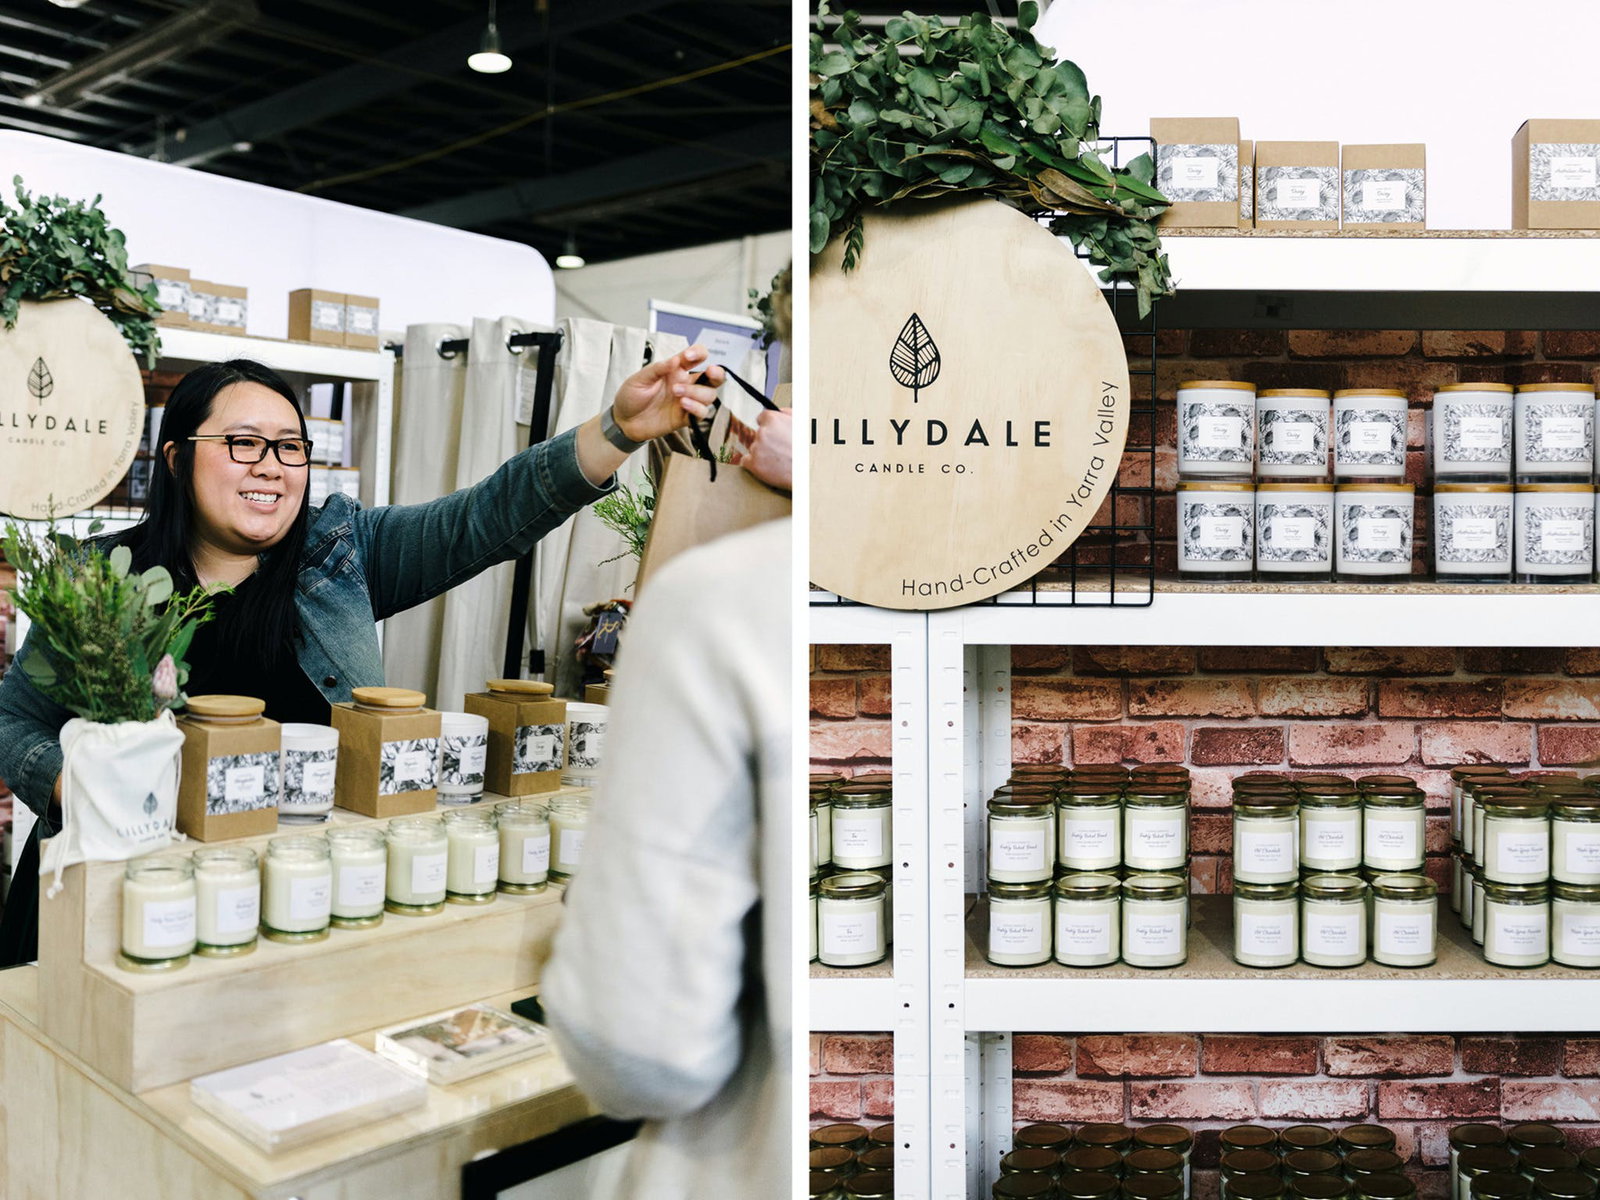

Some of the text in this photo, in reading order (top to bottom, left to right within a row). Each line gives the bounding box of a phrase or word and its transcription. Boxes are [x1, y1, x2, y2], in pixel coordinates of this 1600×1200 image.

[7, 436, 45, 446] CANDLE
[811, 418, 1051, 447] ILLYDALE
[31, 400, 141, 513] Had-Crafted in Yarra Valley
[854, 462, 974, 474] CANDLE CO.
[901, 380, 1119, 597] Hand-Crafted in Yarra Valley
